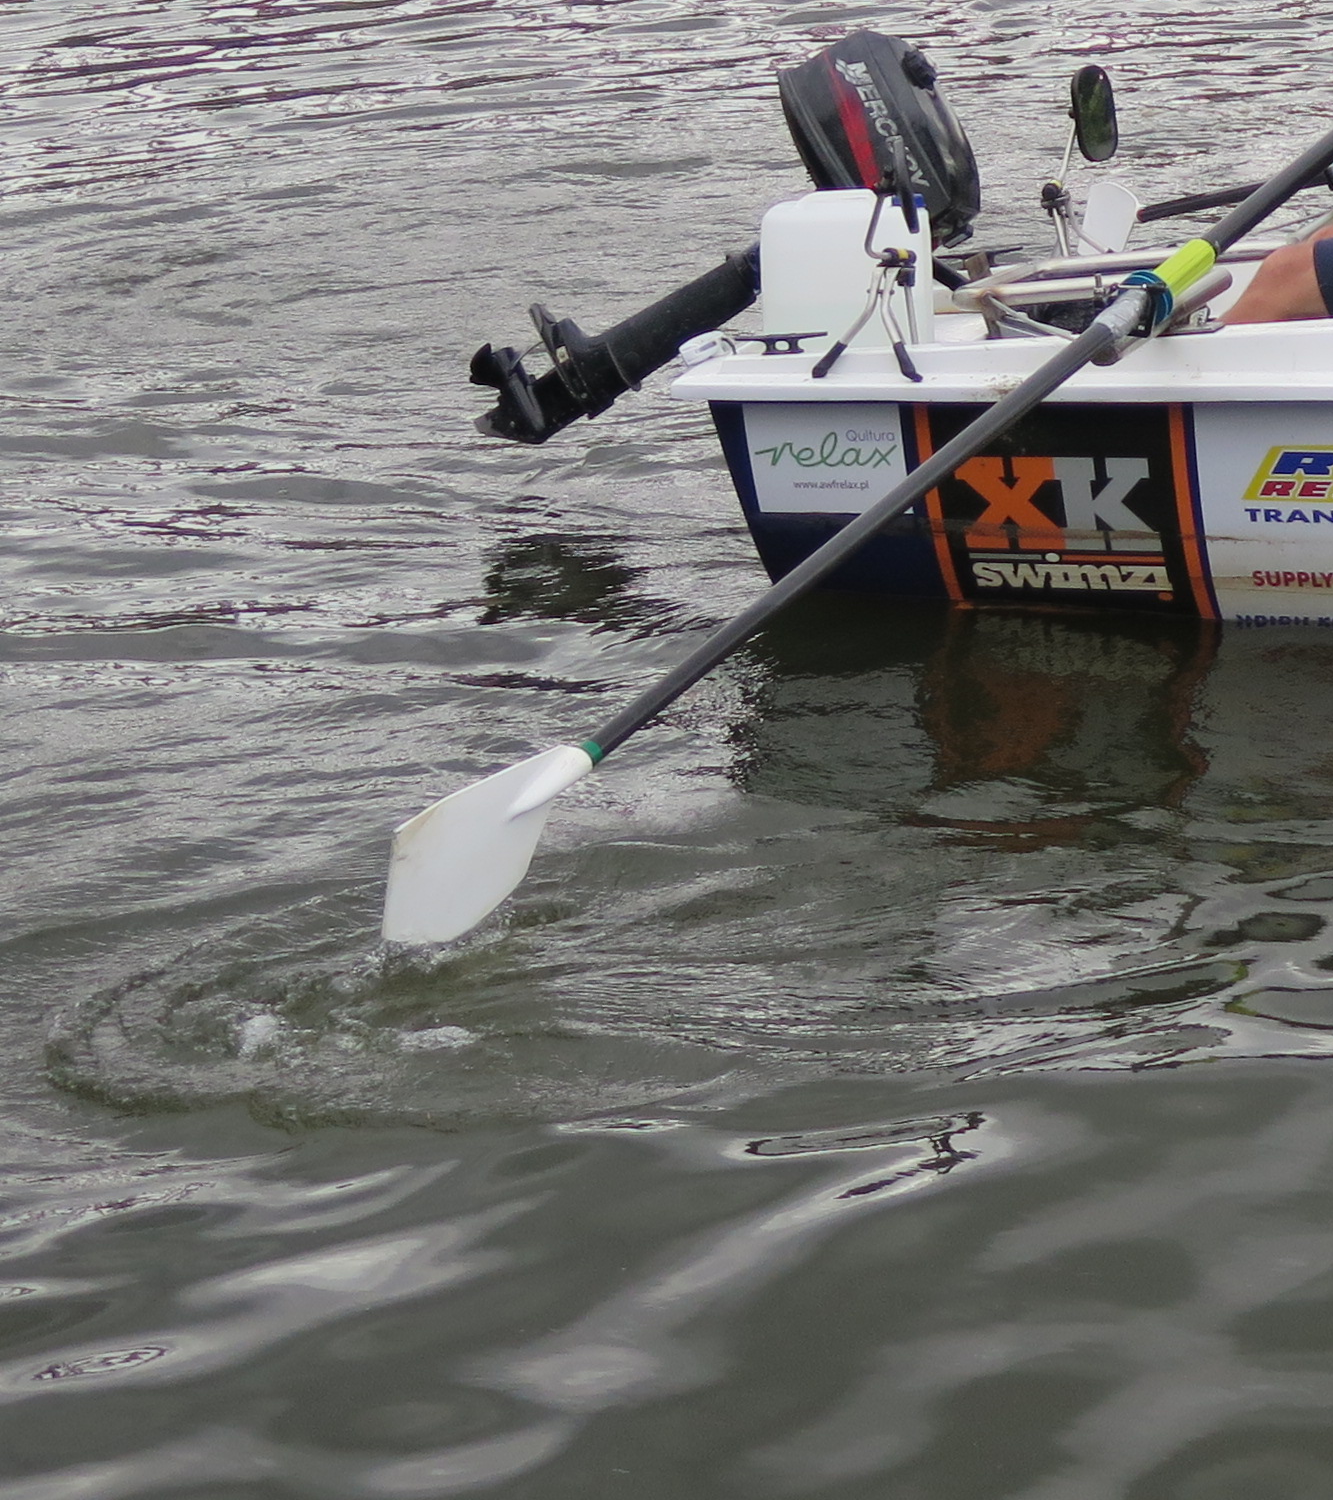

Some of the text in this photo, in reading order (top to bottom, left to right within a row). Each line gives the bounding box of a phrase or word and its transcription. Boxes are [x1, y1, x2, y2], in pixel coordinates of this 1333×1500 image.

[754, 431, 898, 469] relax
[845, 429, 896, 443] Qultura
[954, 456, 1163, 552] XK
